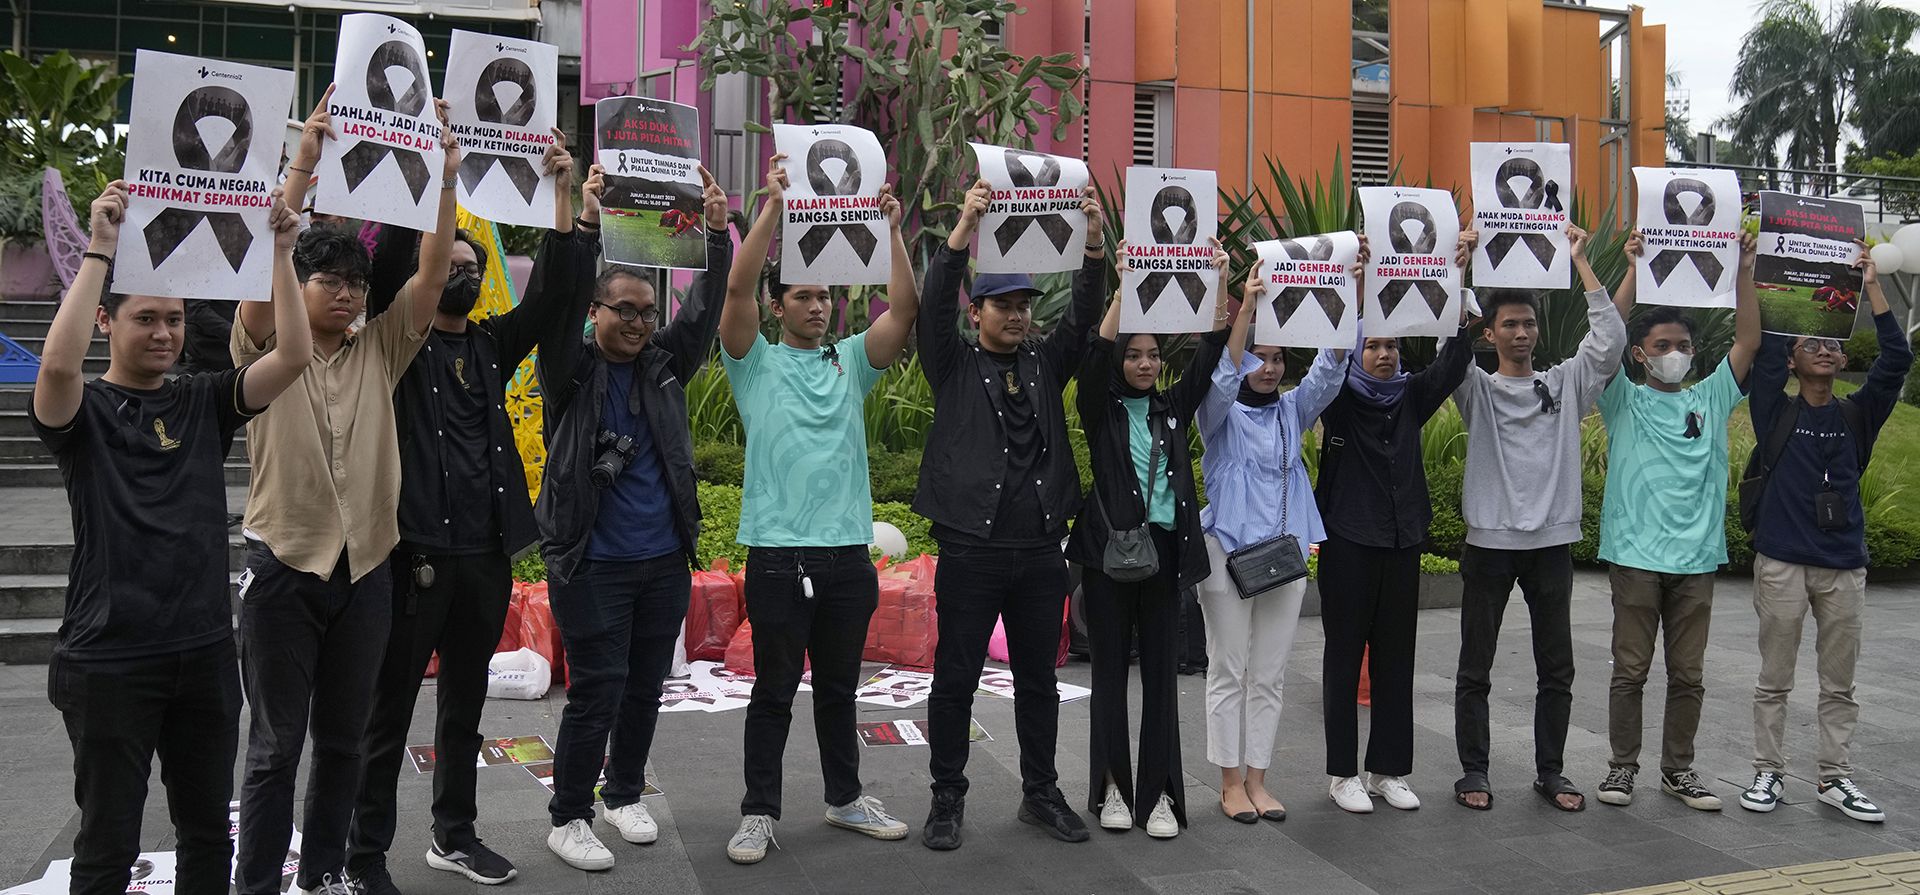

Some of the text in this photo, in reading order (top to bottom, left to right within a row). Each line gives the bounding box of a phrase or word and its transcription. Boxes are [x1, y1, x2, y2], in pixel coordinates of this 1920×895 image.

[211, 70, 242, 80] CentennialZ
[330, 105, 442, 139] DAHLAH, JADI ATLE
[624, 119, 677, 135] AKSI DUKA
[343, 122, 434, 152] LATO-LATO AJA
[447, 123, 554, 144] NAK MUDA DILARANG
[607, 130, 693, 148] 1 JUTA PITA HITAM
[484, 140, 544, 155] KETINGGIAN
[630, 156, 691, 170] UNTUK TIMNAS DAN
[630, 164, 686, 178] PIALA DUNIA U-20
[139, 169, 266, 192] KITA CUMA NEGARA
[128, 184, 272, 208] PENIKMAT SEPAKBOLA
[991, 188, 1080, 200] ADA YANG BATAL
[787, 198, 828, 210] KALAH
[1010, 202, 1047, 213] BUKAN
[789, 211, 837, 223] BANGSA
[1477, 212, 1566, 222] ANAK MUDA DILARANG
[1785, 209, 1838, 224] AKSI DUKA
[1484, 221, 1558, 230] MIMPI KETINGGIAN
[1769, 216, 1855, 235] 1 JUTA PITA HITAM
[1641, 228, 1736, 240] ANAK MUDA DILARANG
[1648, 238, 1727, 249] MIMPI KETINGGIAN
[1789, 240, 1852, 254] UNTUK TIMNAS DAN
[1128, 246, 1214, 257] KALAH MELAWAN
[1788, 247, 1847, 259] PIALA DUNIA U-20
[1128, 258, 1173, 270] BANGSA
[1380, 256, 1446, 266] JADI GENERASI
[1274, 262, 1344, 274] JADI GENERASI
[1377, 268, 1448, 278] REBAHAN (LAGI)
[1272, 274, 1346, 287] REBAHAN (LAGI)
